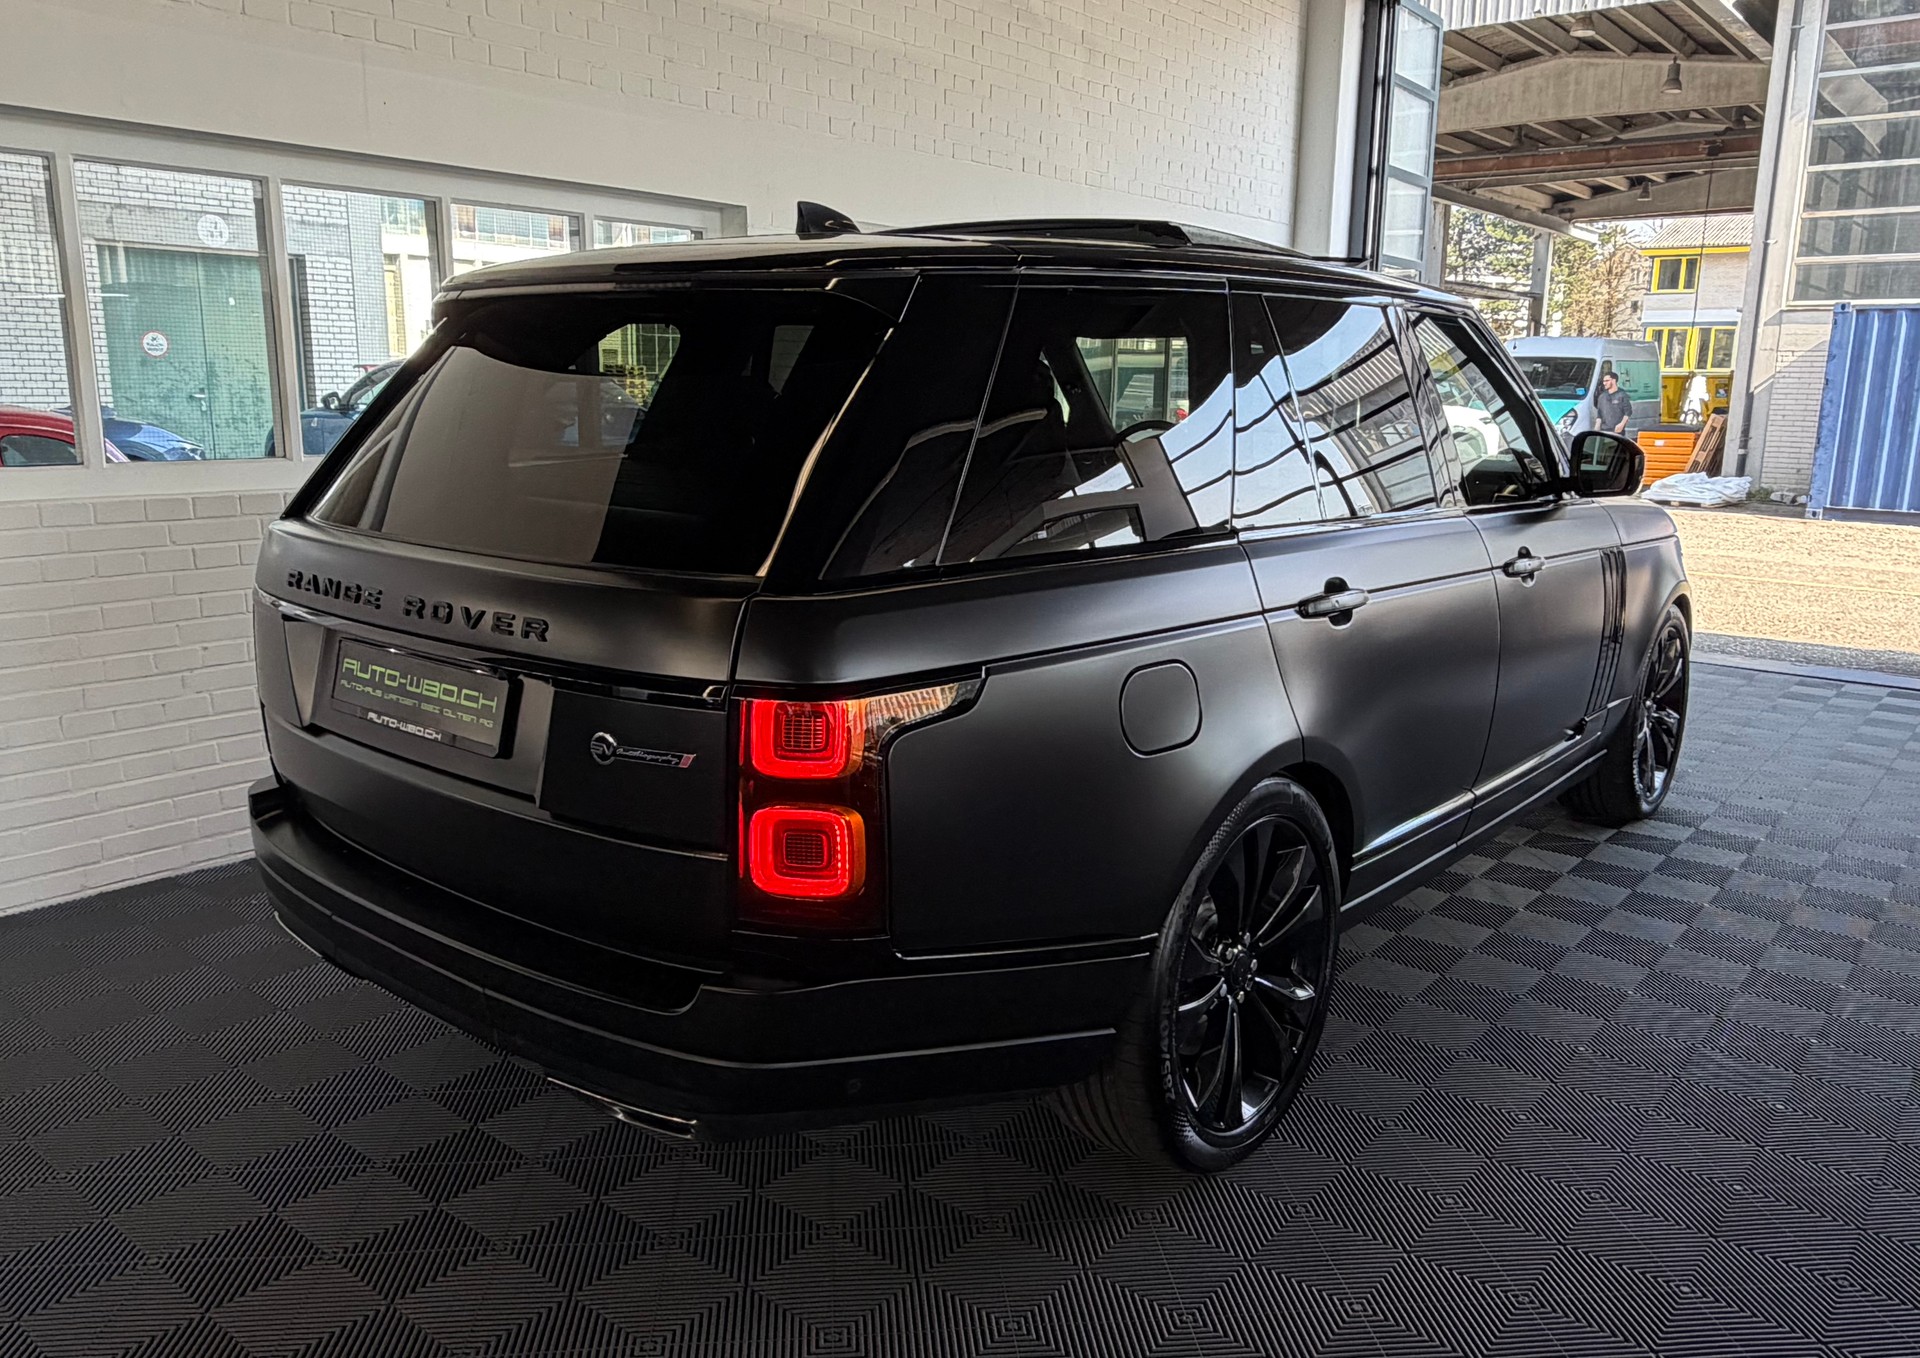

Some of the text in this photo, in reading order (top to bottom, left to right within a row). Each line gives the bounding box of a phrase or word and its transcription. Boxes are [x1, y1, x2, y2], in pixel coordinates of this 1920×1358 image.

[287, 568, 550, 643] RANGE ROVER
[342, 658, 498, 713] AUTO-WBO.CH
[367, 711, 442, 741] AUTO-WBO.CH
